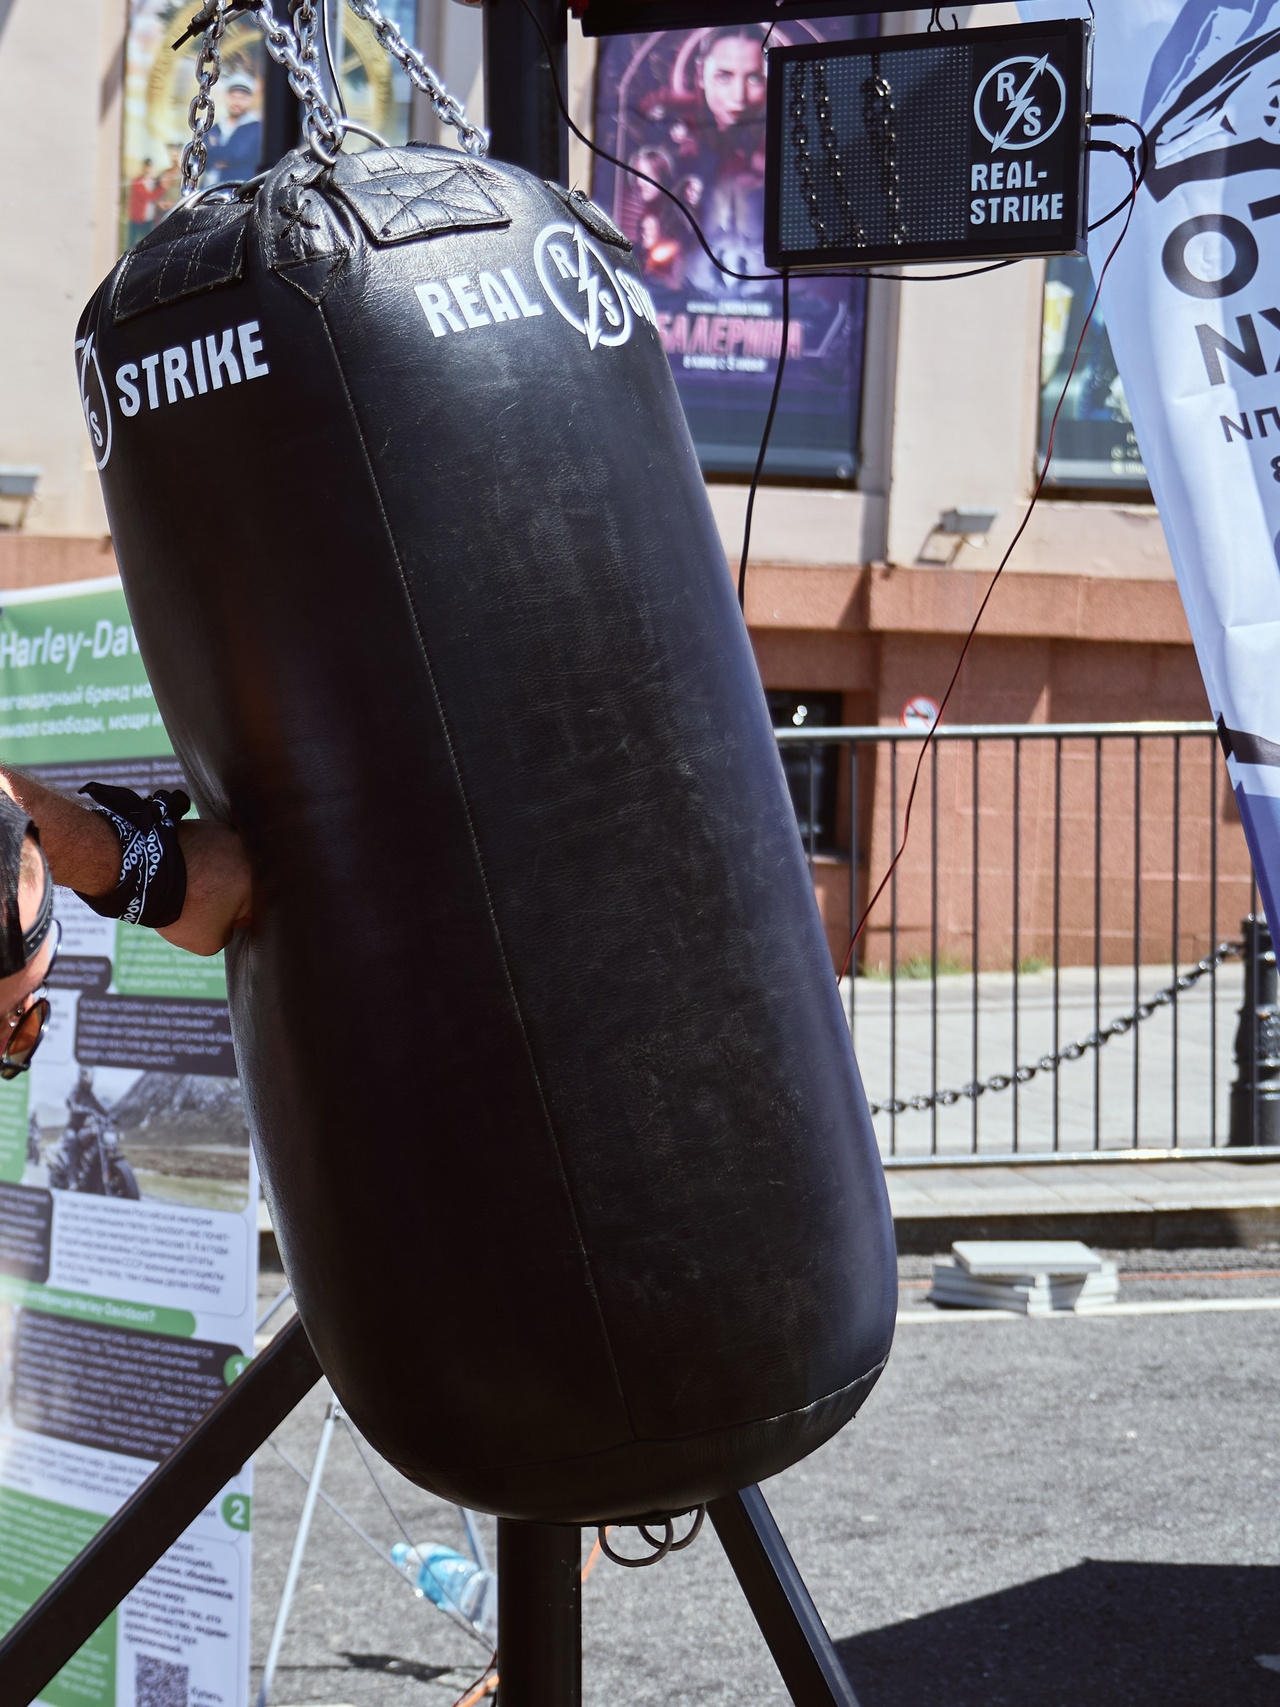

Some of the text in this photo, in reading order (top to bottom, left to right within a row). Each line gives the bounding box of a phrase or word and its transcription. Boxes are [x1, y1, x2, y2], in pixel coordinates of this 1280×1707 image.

[970, 160, 1048, 192] REAL-
[970, 193, 1064, 225] STRIKE
[414, 267, 544, 339] REAL
[656, 313, 803, 360] БАЛЕРИНА
[116, 321, 270, 418] STRIKE
[231, 1499, 246, 1525] 2
